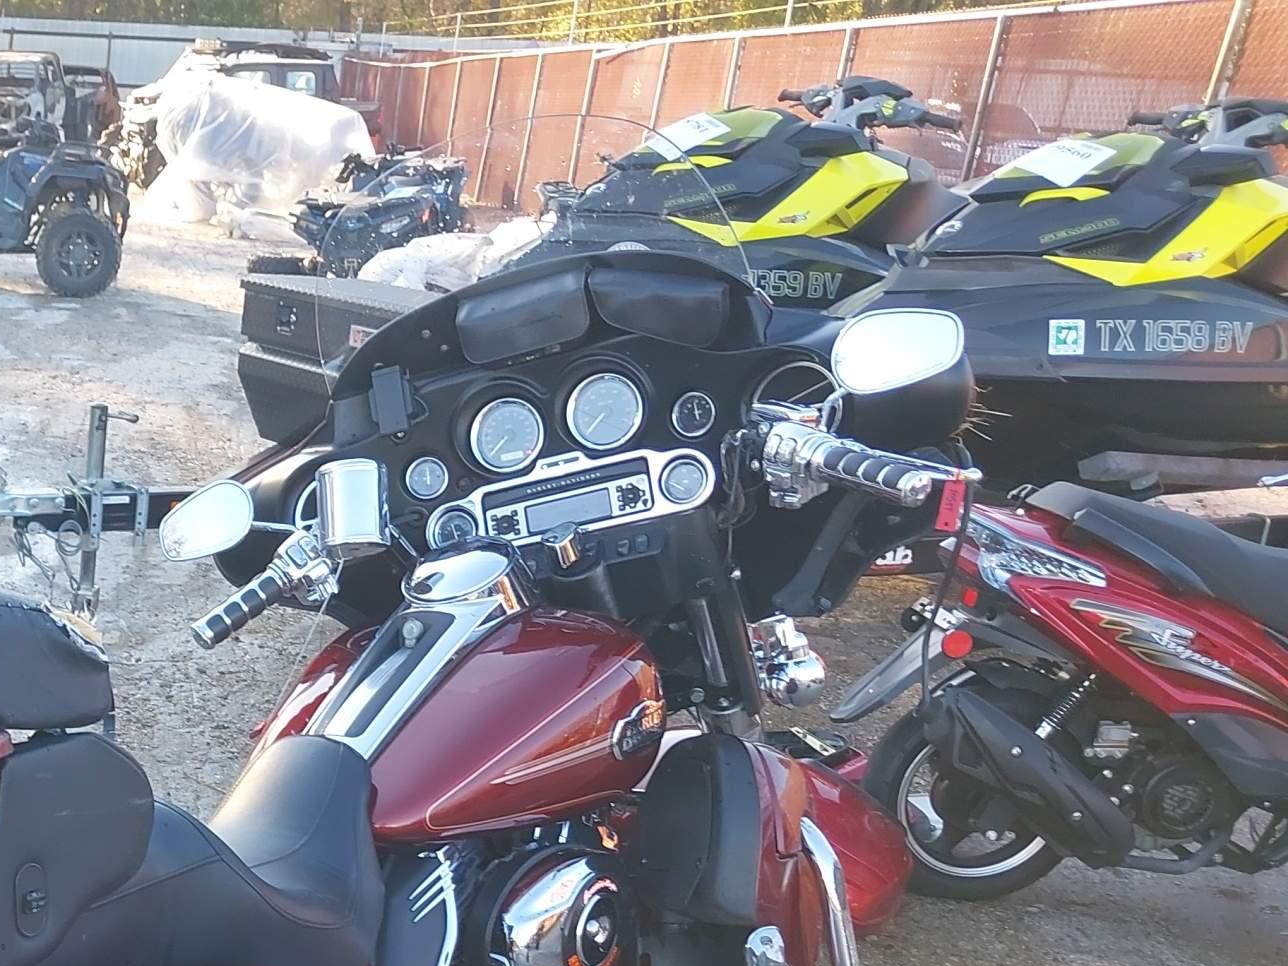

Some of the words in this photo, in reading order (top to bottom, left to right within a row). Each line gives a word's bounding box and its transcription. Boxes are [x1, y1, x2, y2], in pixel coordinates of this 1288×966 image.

[807, 270, 843, 300] BV
[1096, 319, 1136, 352] TX
[1143, 319, 1210, 353] 1658
[1213, 320, 1254, 354] BV
